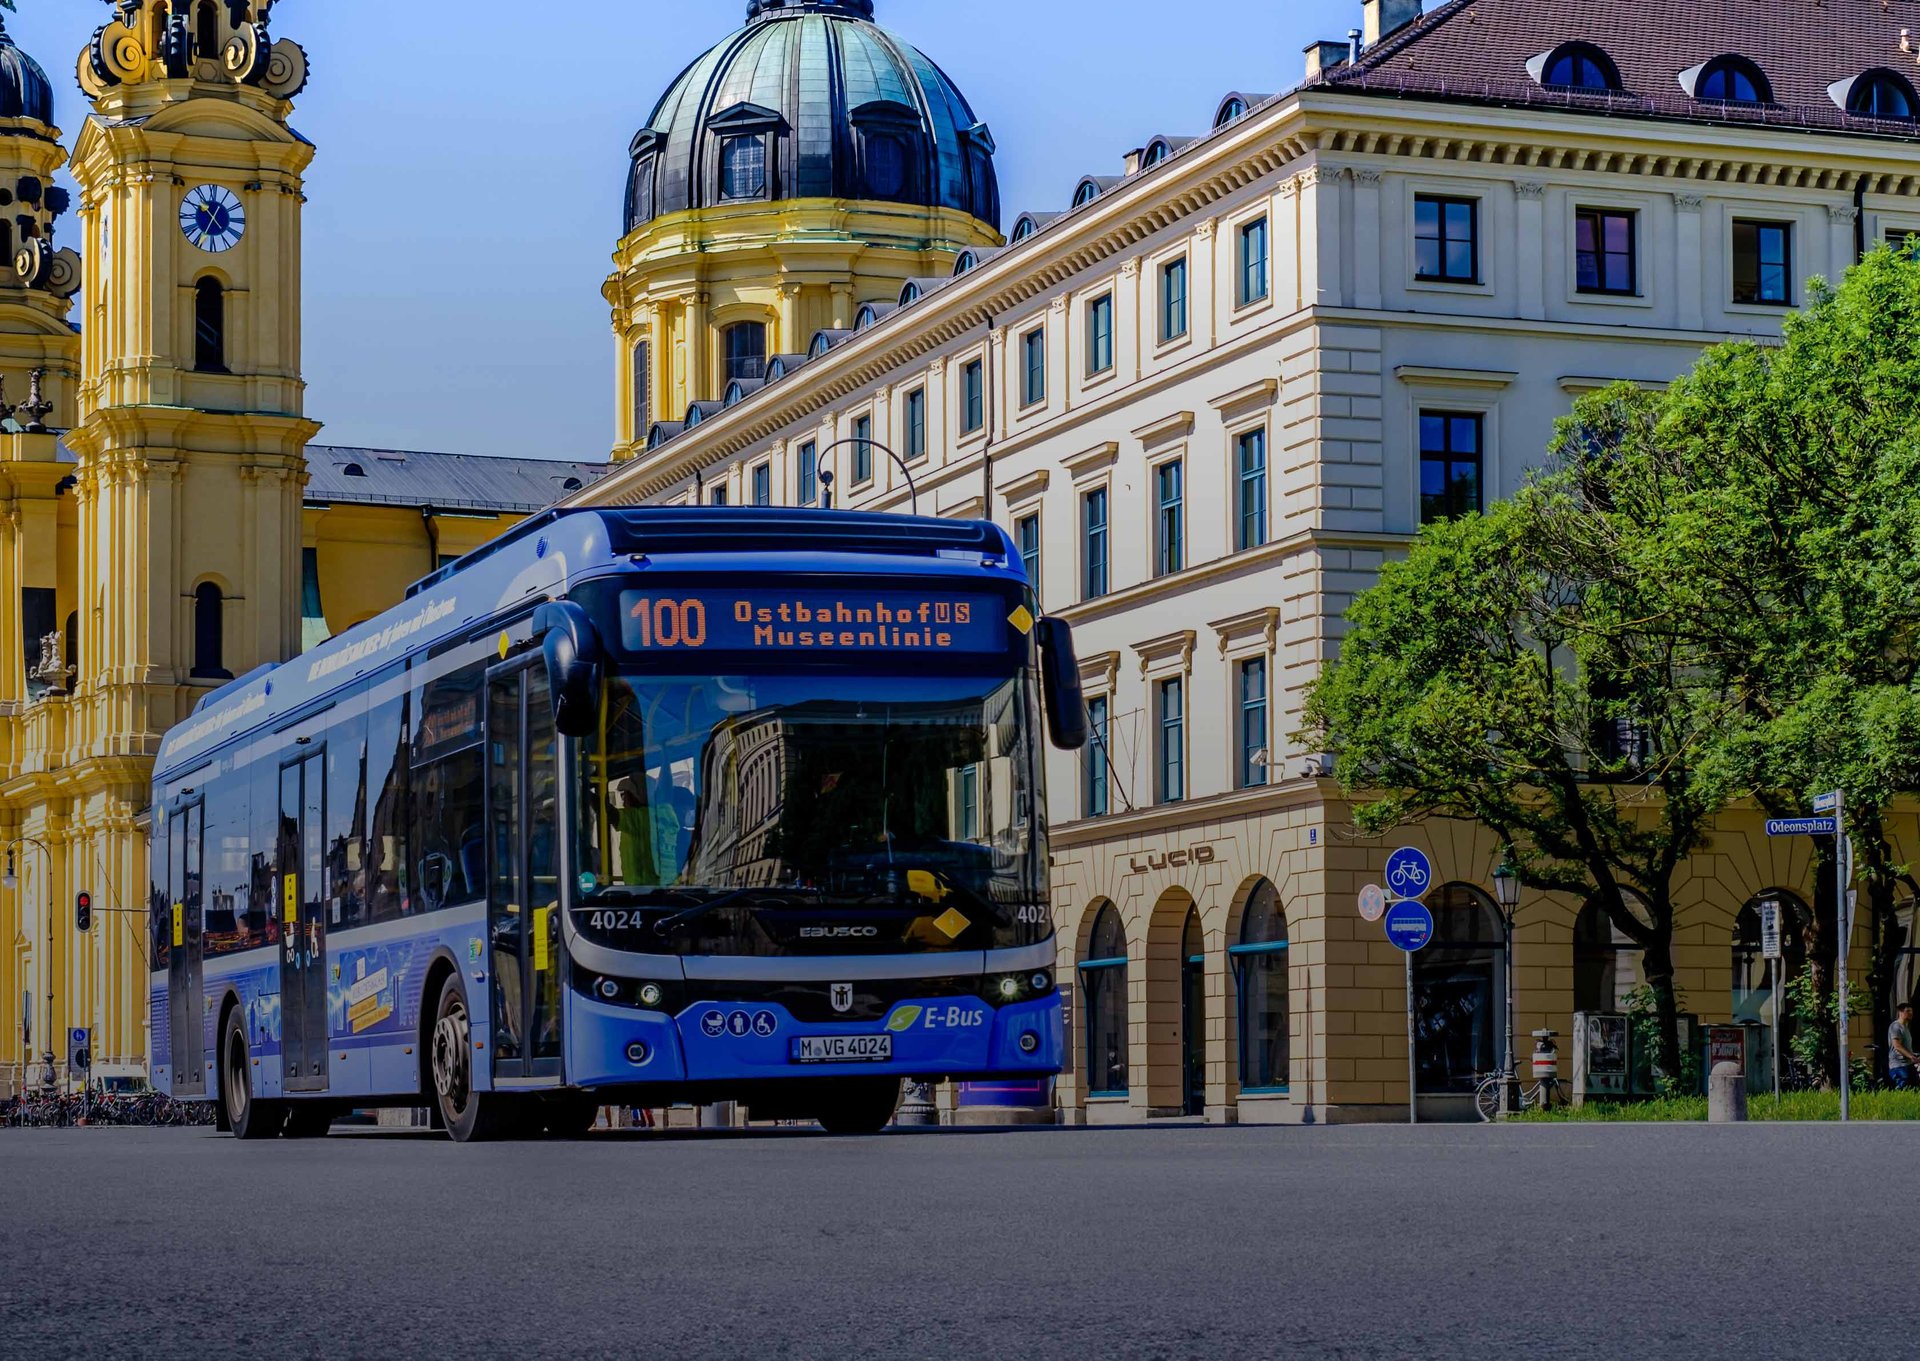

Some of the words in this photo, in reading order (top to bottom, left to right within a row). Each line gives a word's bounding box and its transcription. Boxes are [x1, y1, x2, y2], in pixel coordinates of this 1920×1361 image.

[631, 598, 706, 647] 100
[734, 601, 930, 623] Ostbahnhof
[754, 624, 952, 647] Museenlinie
[1770, 820, 1834, 833] Odeonsplatz
[1130, 846, 1215, 873] LUCID
[590, 910, 643, 930] 4024
[799, 926, 878, 937] EBUSCO
[924, 1006, 984, 1029] E-Bus
